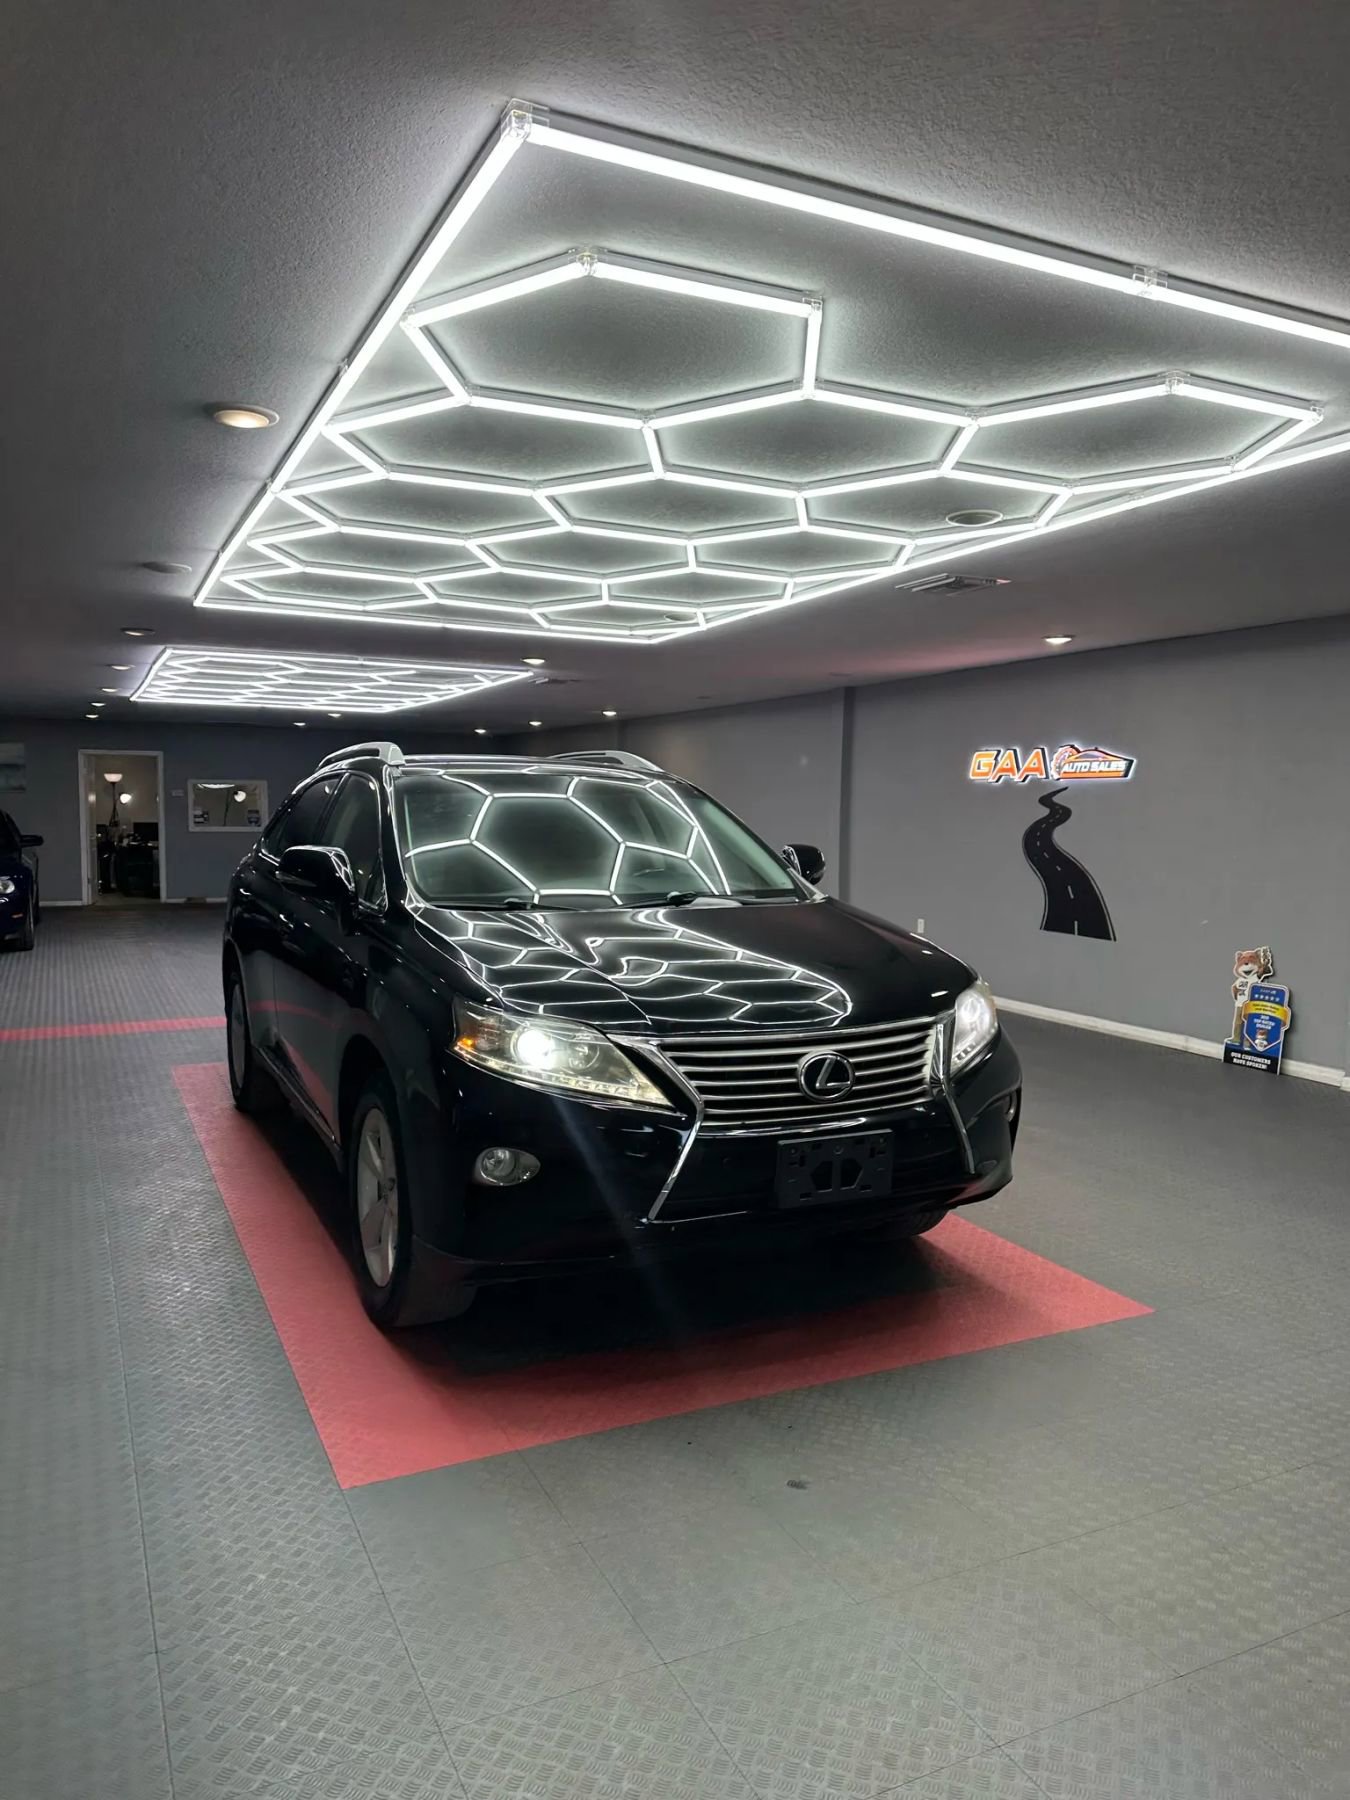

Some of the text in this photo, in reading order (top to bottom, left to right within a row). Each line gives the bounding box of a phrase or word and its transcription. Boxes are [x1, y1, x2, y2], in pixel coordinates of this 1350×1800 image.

[970, 748, 1126, 783] GAA AUTO SALES
[1242, 1054, 1271, 1065] CUSTOMERS
